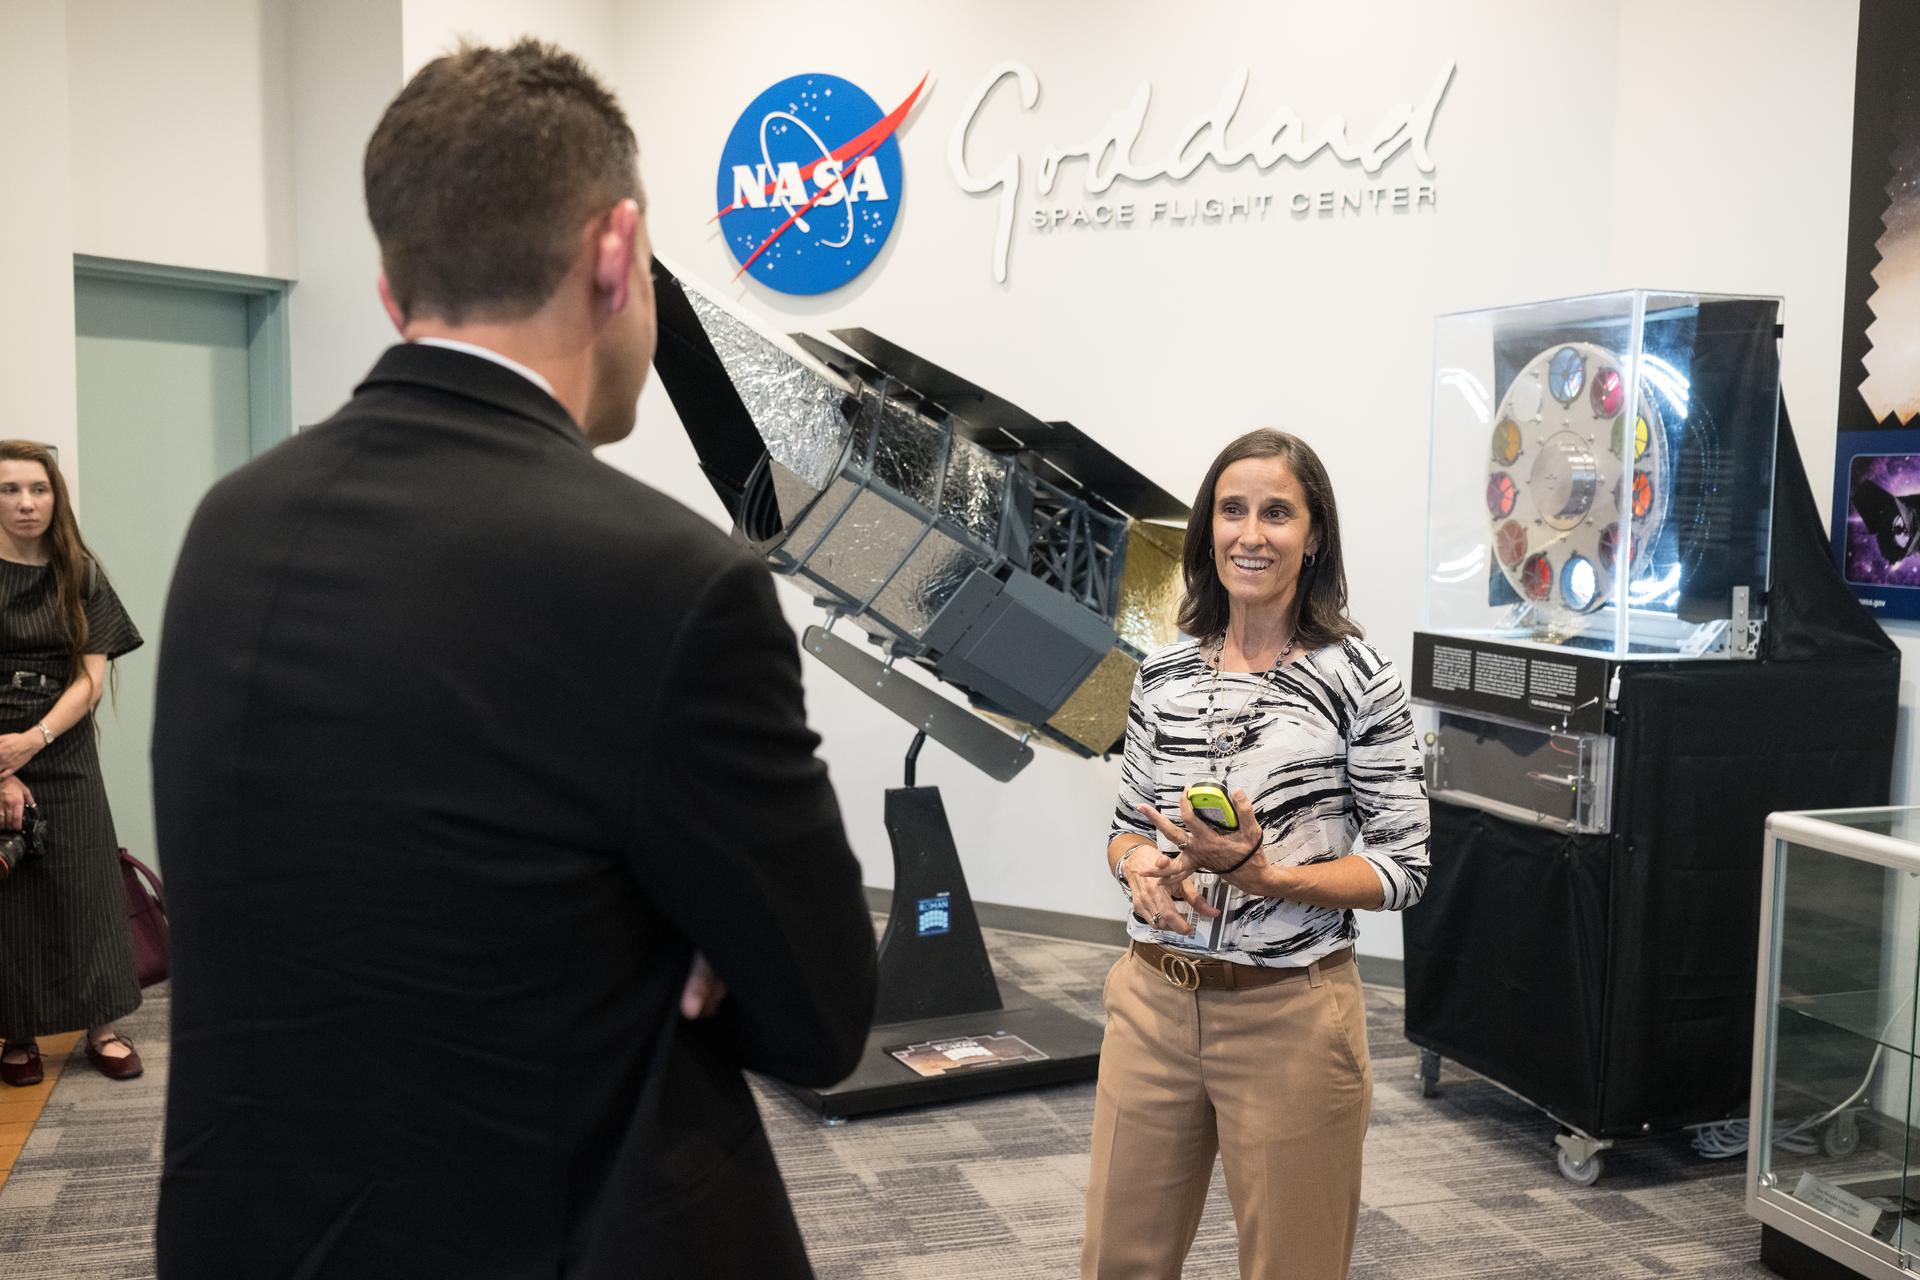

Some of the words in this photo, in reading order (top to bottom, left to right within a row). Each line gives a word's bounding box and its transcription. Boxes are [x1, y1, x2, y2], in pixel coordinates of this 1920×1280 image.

[731, 155, 889, 209] NASA
[948, 59, 1458, 284] Goddard
[1032, 202, 1136, 229] SPACE
[1152, 193, 1274, 222] FLIGHT
[1288, 184, 1437, 213] CENTER
